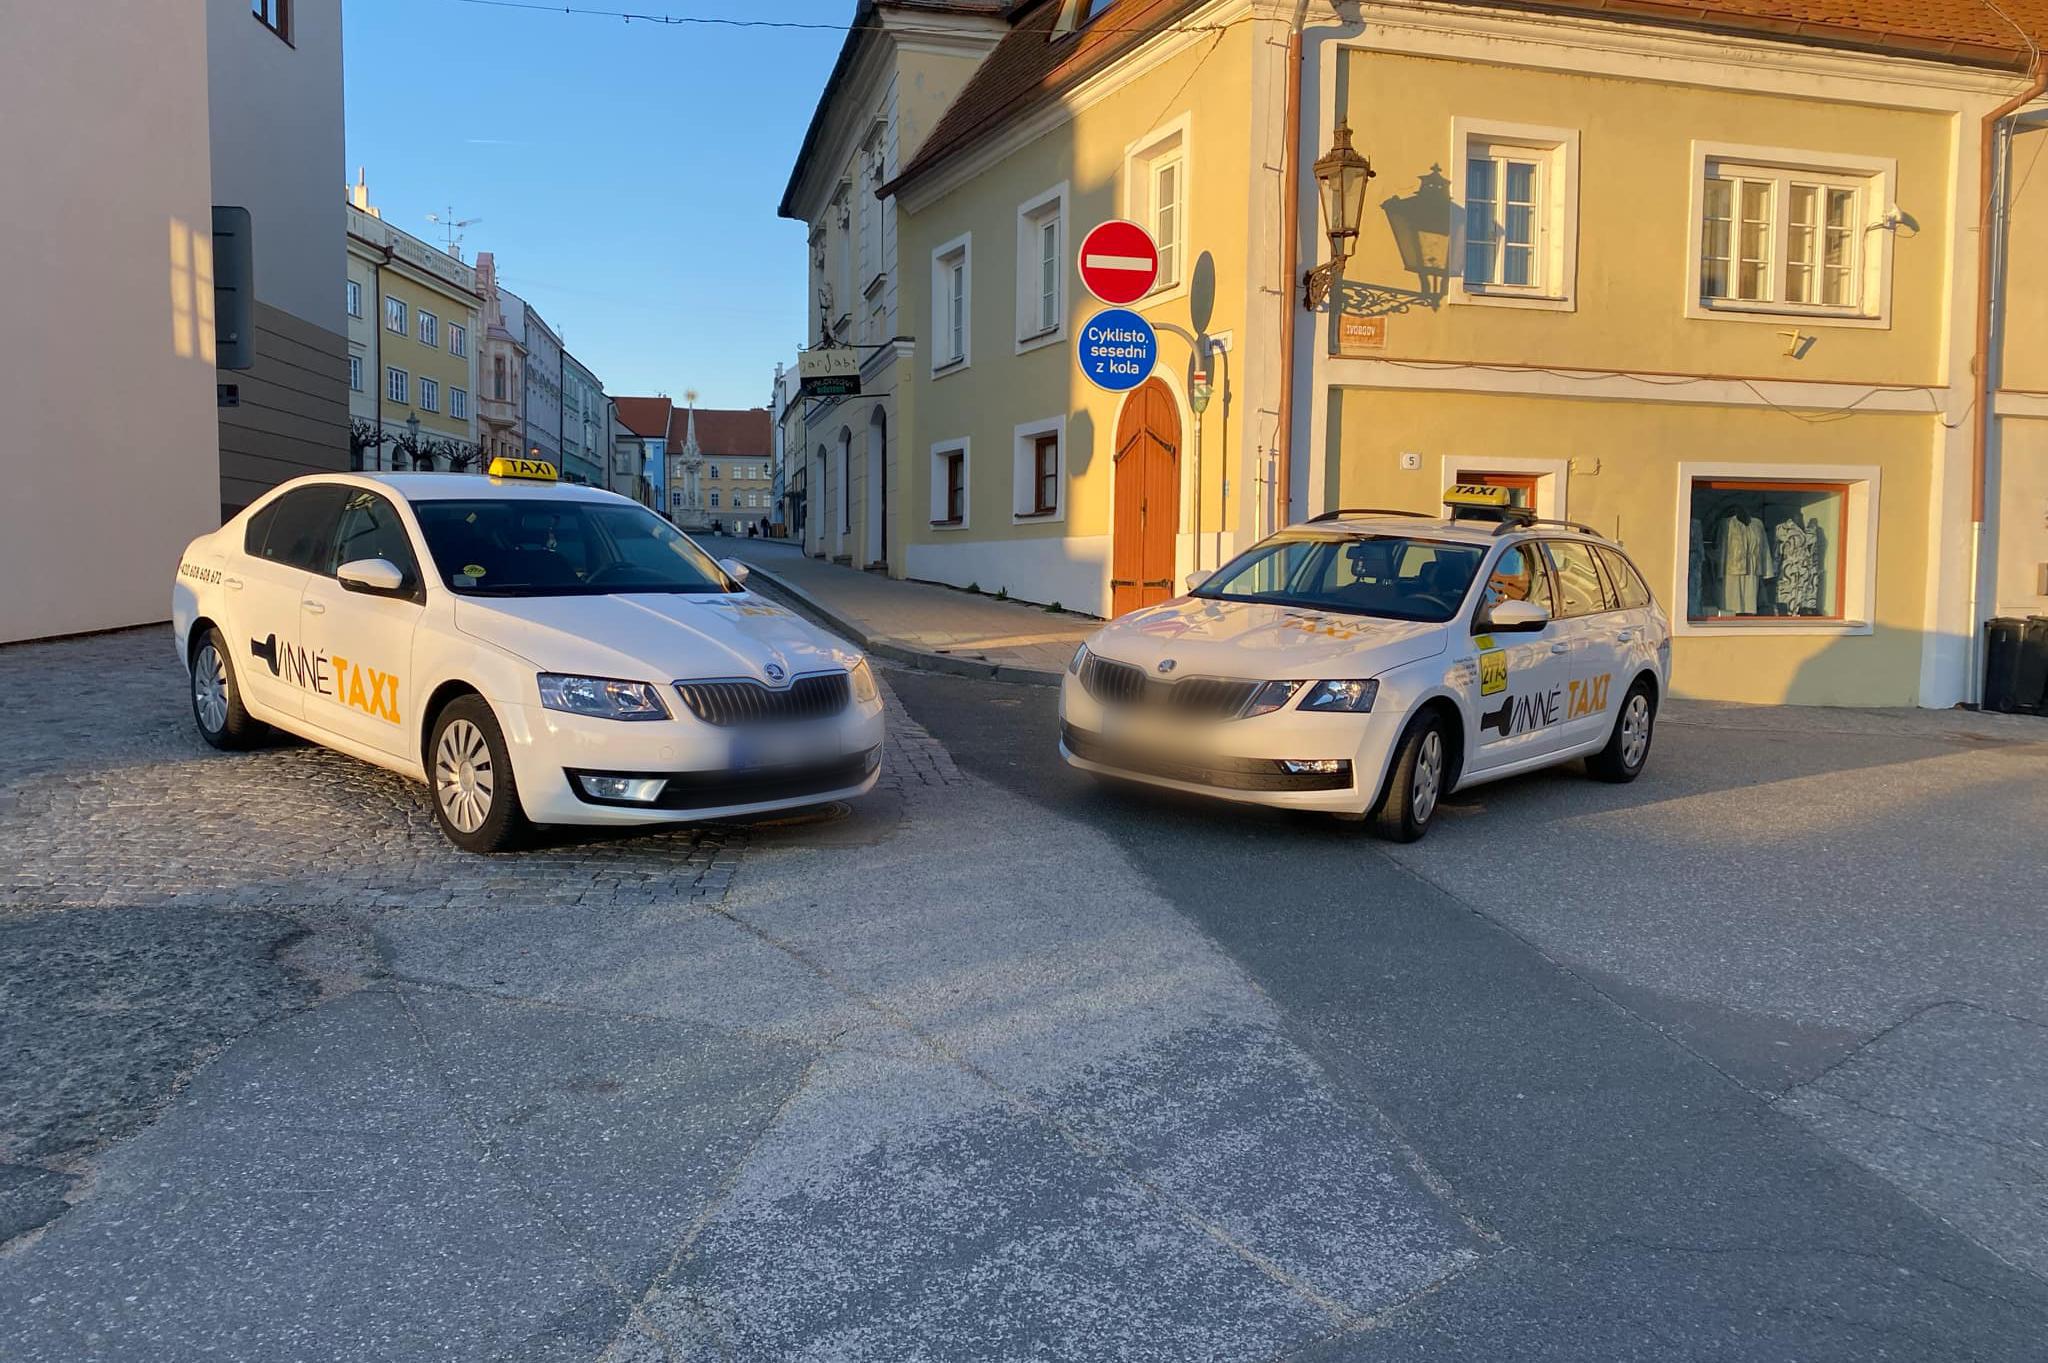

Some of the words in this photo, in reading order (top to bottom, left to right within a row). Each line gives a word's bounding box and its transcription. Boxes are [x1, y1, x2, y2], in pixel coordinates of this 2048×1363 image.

[1088, 326, 1149, 344] Cyklisto,
[1090, 344, 1147, 359] sesedni
[1095, 362, 1105, 373] z
[1109, 358, 1140, 375] kola
[505, 459, 551, 475] TAXI
[1408, 456, 1415, 466] 5
[1455, 485, 1497, 496] TAXI
[332, 654, 401, 725] TAXI
[1567, 672, 1612, 720] TAXI
